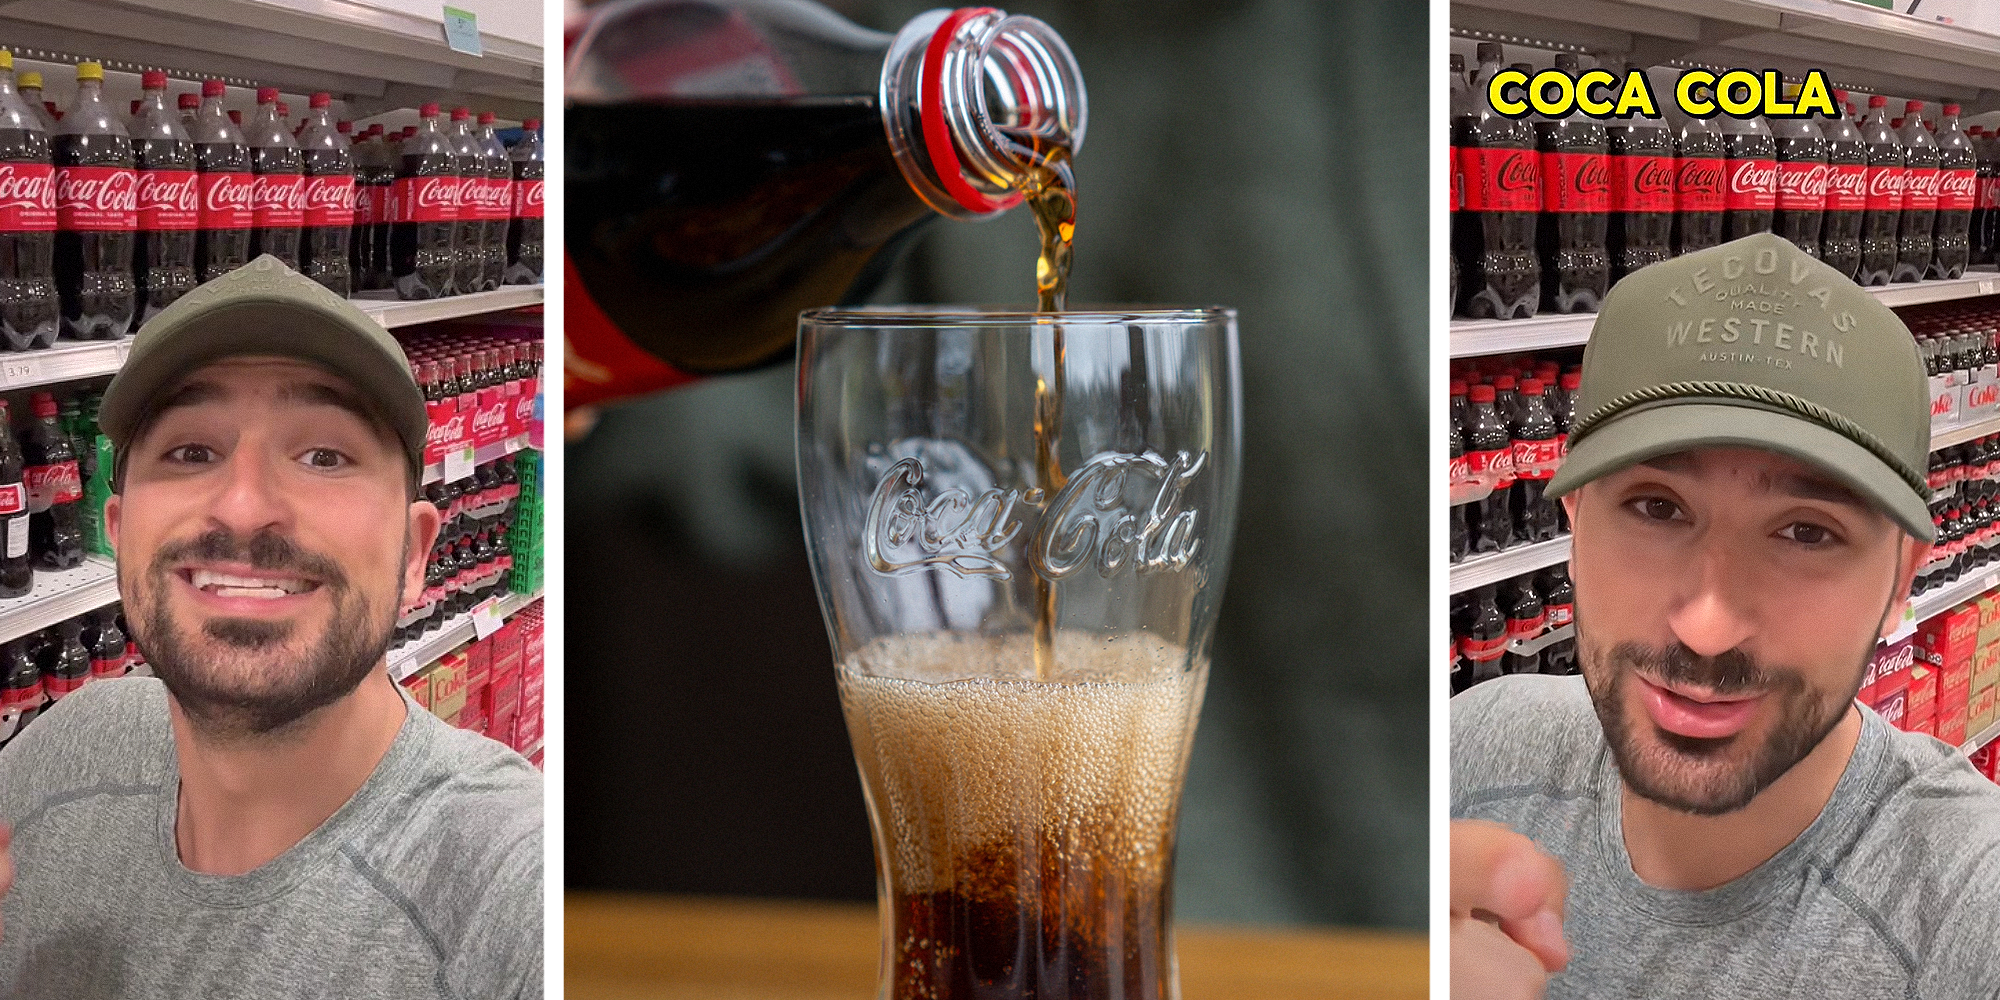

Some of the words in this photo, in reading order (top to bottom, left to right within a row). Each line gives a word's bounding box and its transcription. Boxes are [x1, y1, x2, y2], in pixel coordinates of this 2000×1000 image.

[1667, 250, 1857, 333] TECOVAS
[1730, 300, 1784, 315] MADE
[1667, 317, 1844, 369] WESTERN
[862, 450, 1209, 581] Coca-Cola
